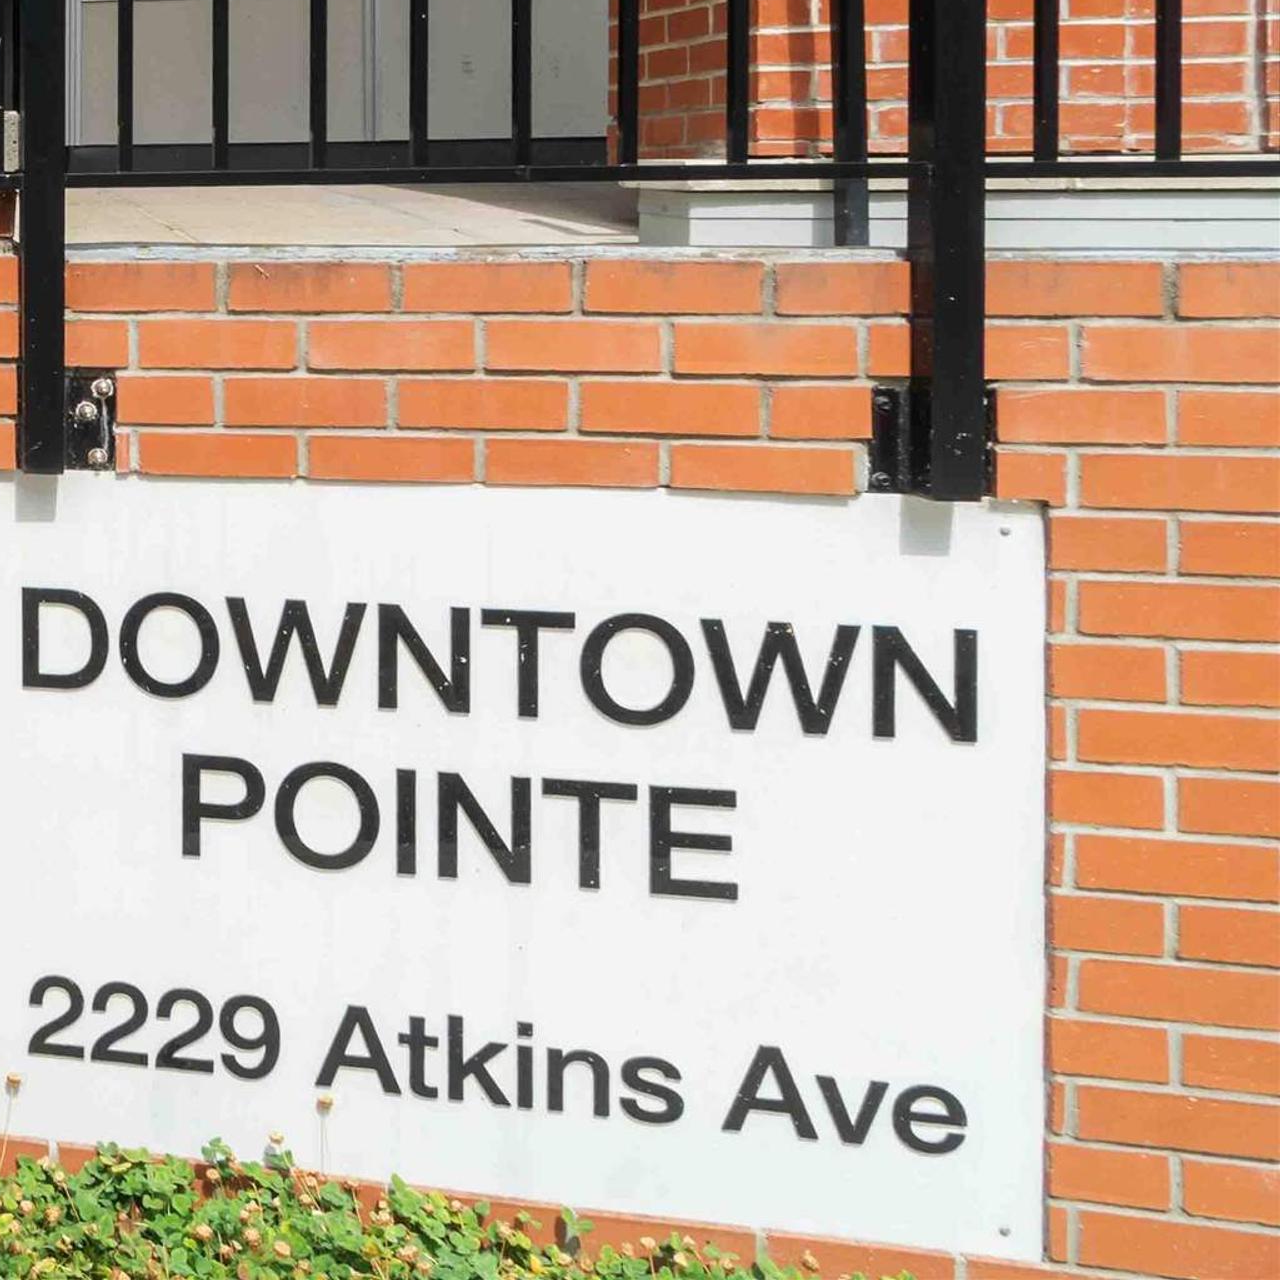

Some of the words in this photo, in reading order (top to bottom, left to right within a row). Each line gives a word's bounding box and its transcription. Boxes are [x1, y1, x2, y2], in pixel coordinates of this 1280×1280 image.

[22, 587, 978, 744] DOWNTOWN
[182, 753, 739, 902] POINTE
[28, 976, 280, 1081] 2229
[316, 1006, 684, 1125] Atkins
[722, 1046, 968, 1155] Ave
